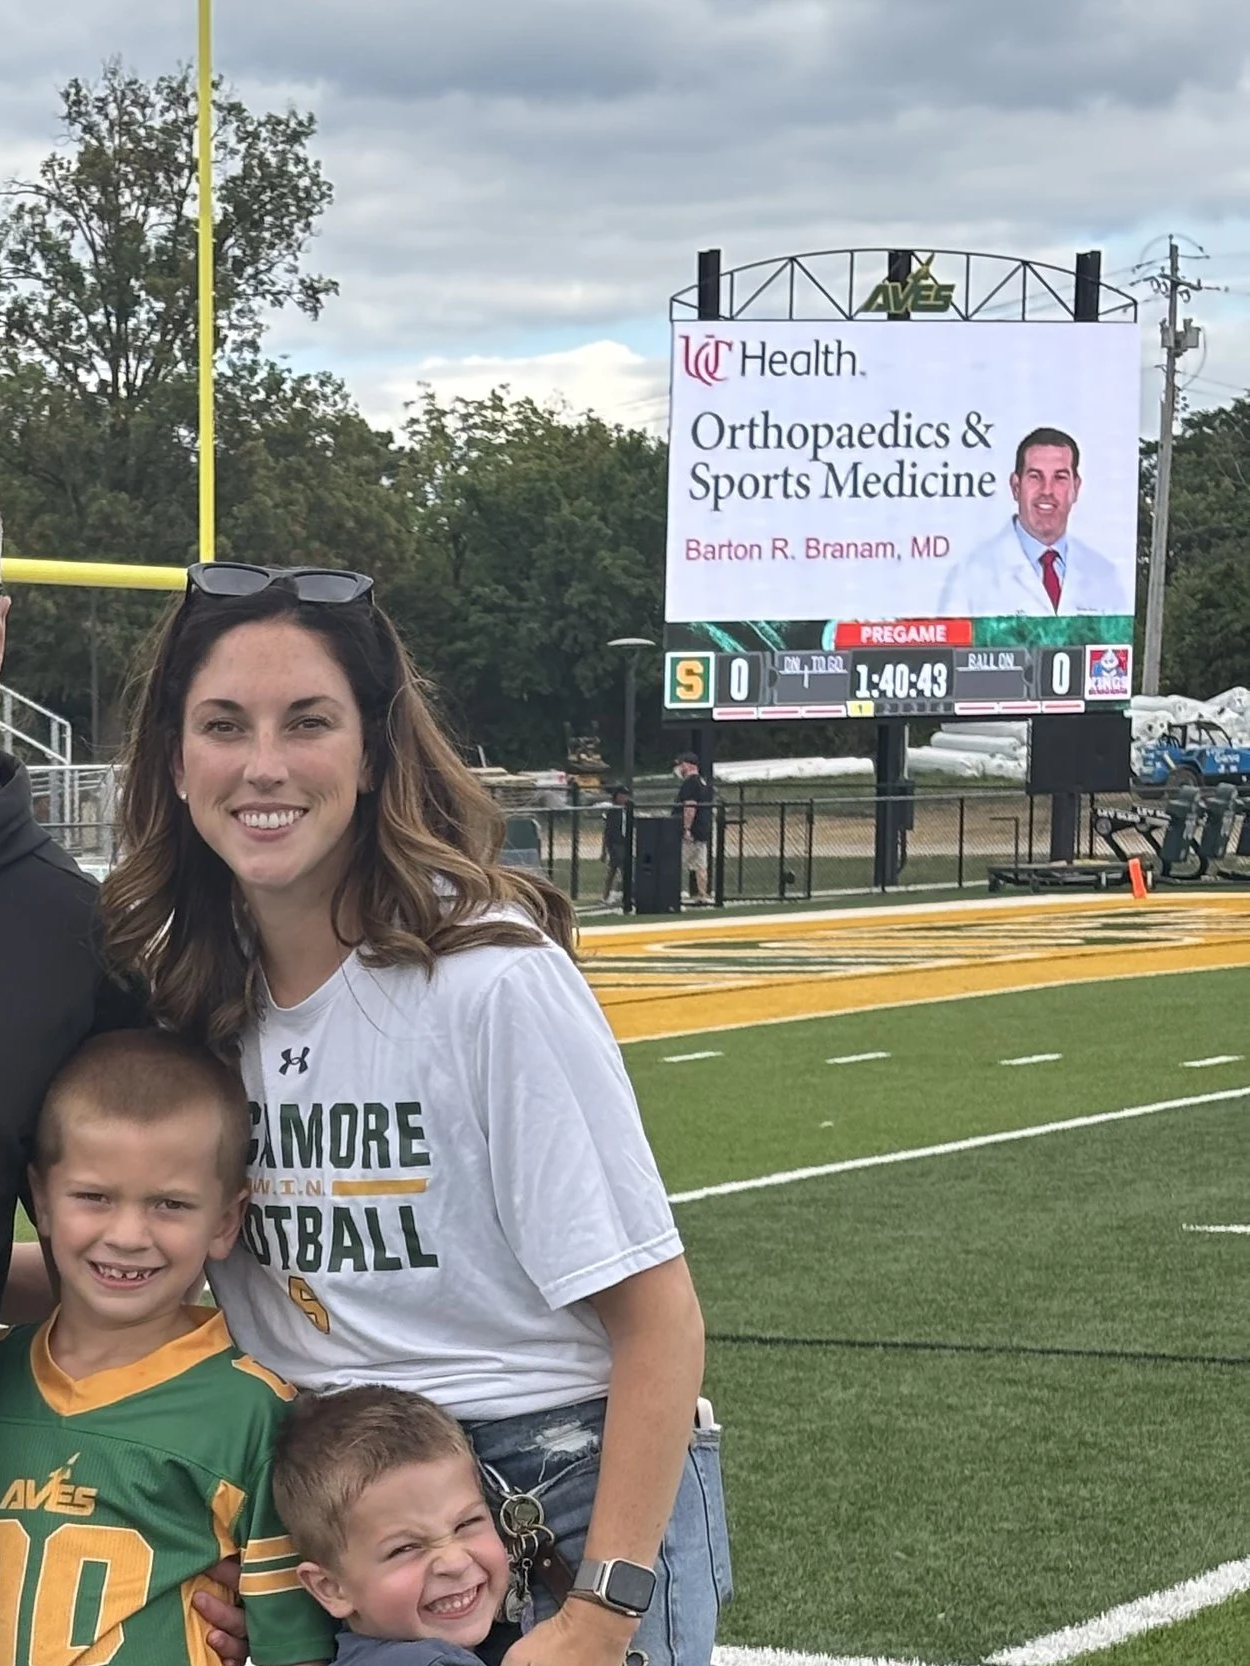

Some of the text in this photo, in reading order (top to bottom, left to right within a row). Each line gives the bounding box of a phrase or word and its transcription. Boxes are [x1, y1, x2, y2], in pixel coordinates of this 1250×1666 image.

[857, 264, 956, 314] AVES
[691, 410, 994, 461] Orthopaedics &
[688, 460, 996, 511] Sports Medicine
[685, 536, 950, 561] Barton R. Branam, MD
[861, 625, 947, 643] PREGAME
[676, 660, 704, 699] S
[730, 658, 749, 701] 0
[856, 663, 948, 698] 1:40:43
[1052, 652, 1070, 694] 0
